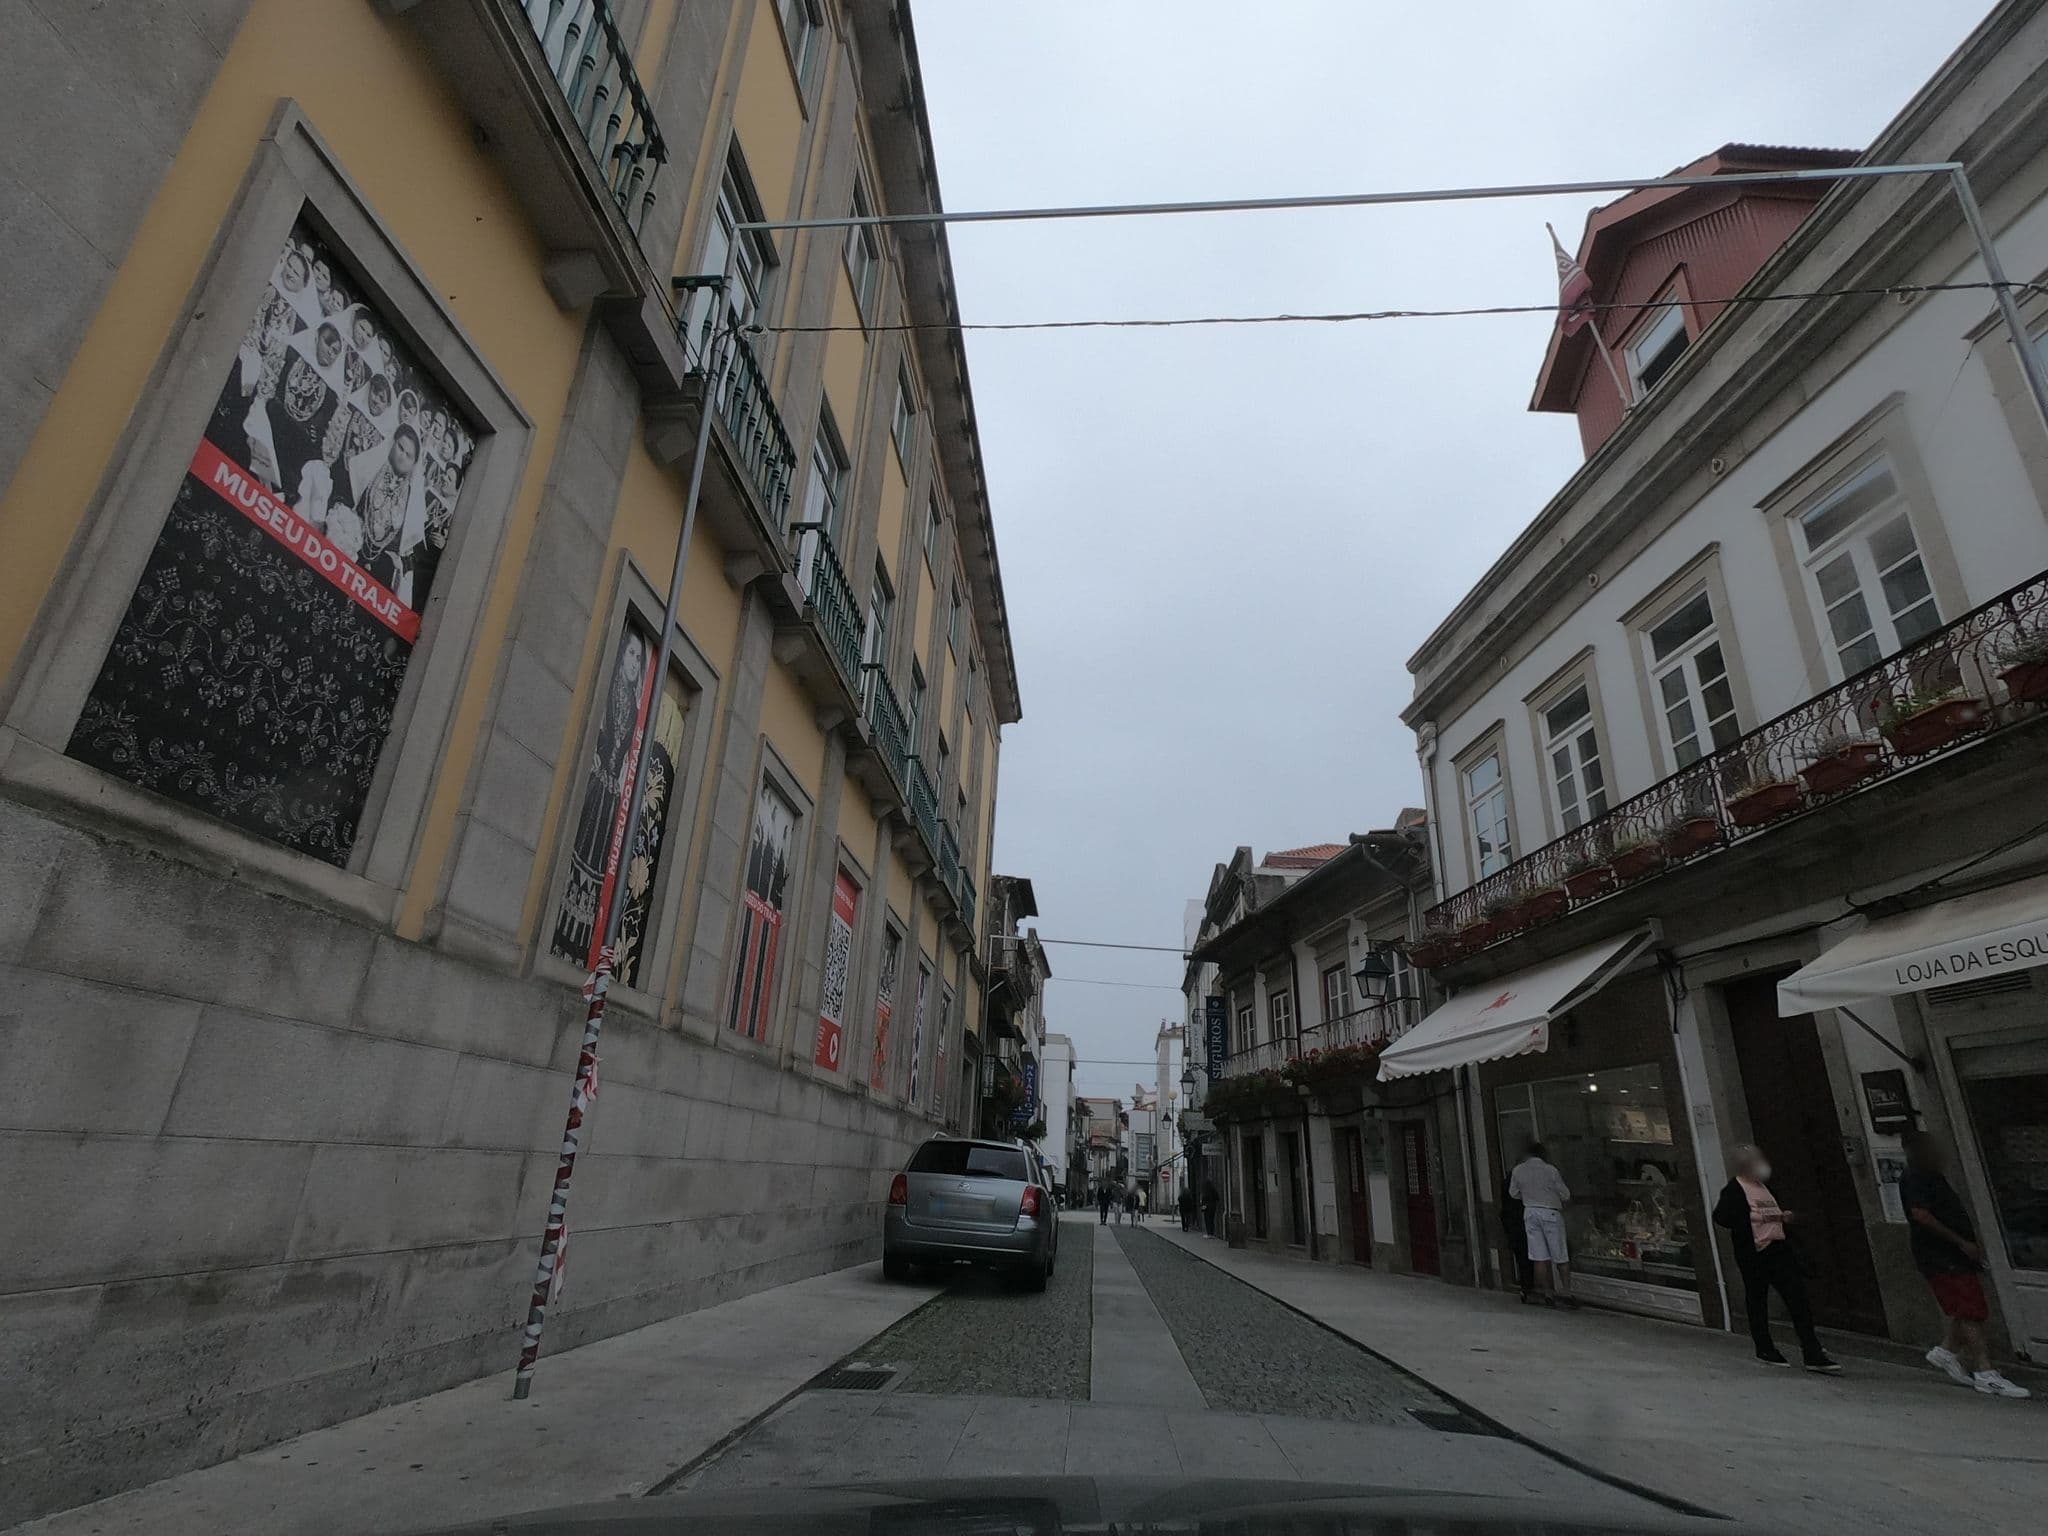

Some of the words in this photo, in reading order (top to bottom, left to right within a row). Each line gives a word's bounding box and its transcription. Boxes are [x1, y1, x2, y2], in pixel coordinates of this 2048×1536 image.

[213, 461, 305, 544] MUSEU
[303, 535, 338, 572] DO
[340, 561, 402, 626] TRAJE
[608, 811, 628, 877] MUSEU
[622, 784, 634, 810] DO
[1896, 958, 1949, 985] LOJA
[1950, 951, 1983, 973] DA
[1211, 1017, 1223, 1080] SEGUROS
